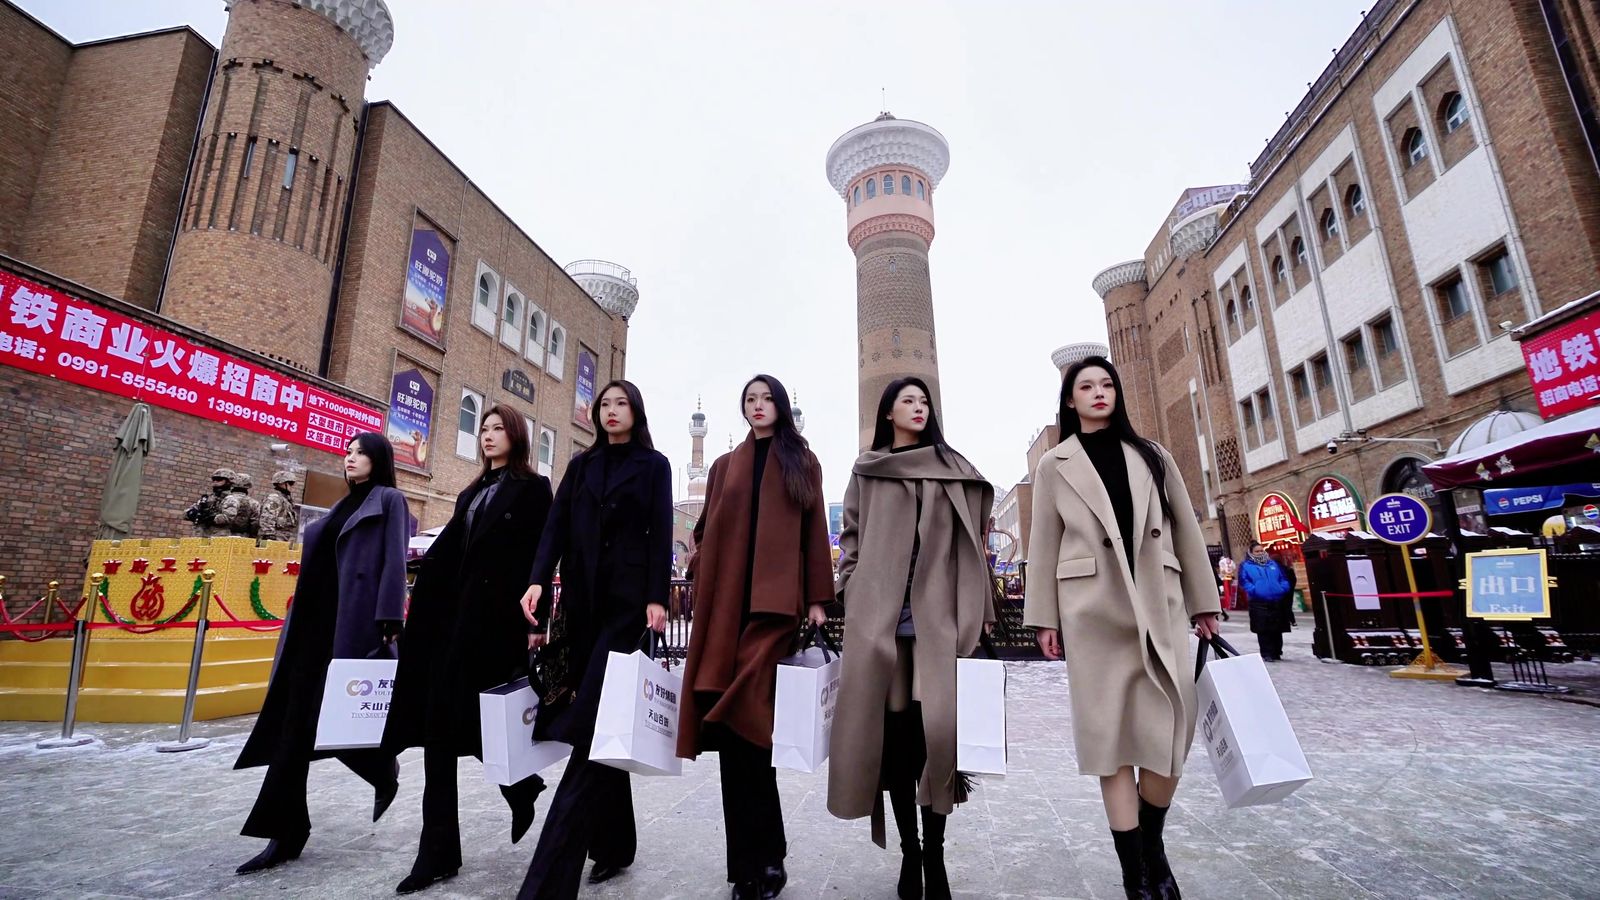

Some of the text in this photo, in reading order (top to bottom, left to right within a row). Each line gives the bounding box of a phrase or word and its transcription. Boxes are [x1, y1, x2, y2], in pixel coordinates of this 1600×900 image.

[0, 284, 304, 413] 铁商业火爆招商中
[1529, 327, 1600, 384] 地铁
[57, 352, 198, 404] 0991-8555480
[207, 397, 298, 433] 13999199373
[1513, 494, 1543, 507] PEPSI
[1379, 509, 1415, 524] 出口
[1387, 523, 1411, 535] EXIT
[102, 557, 208, 575] 首府卫士
[1479, 574, 1535, 596] 出口
[1490, 604, 1526, 613] Exit
